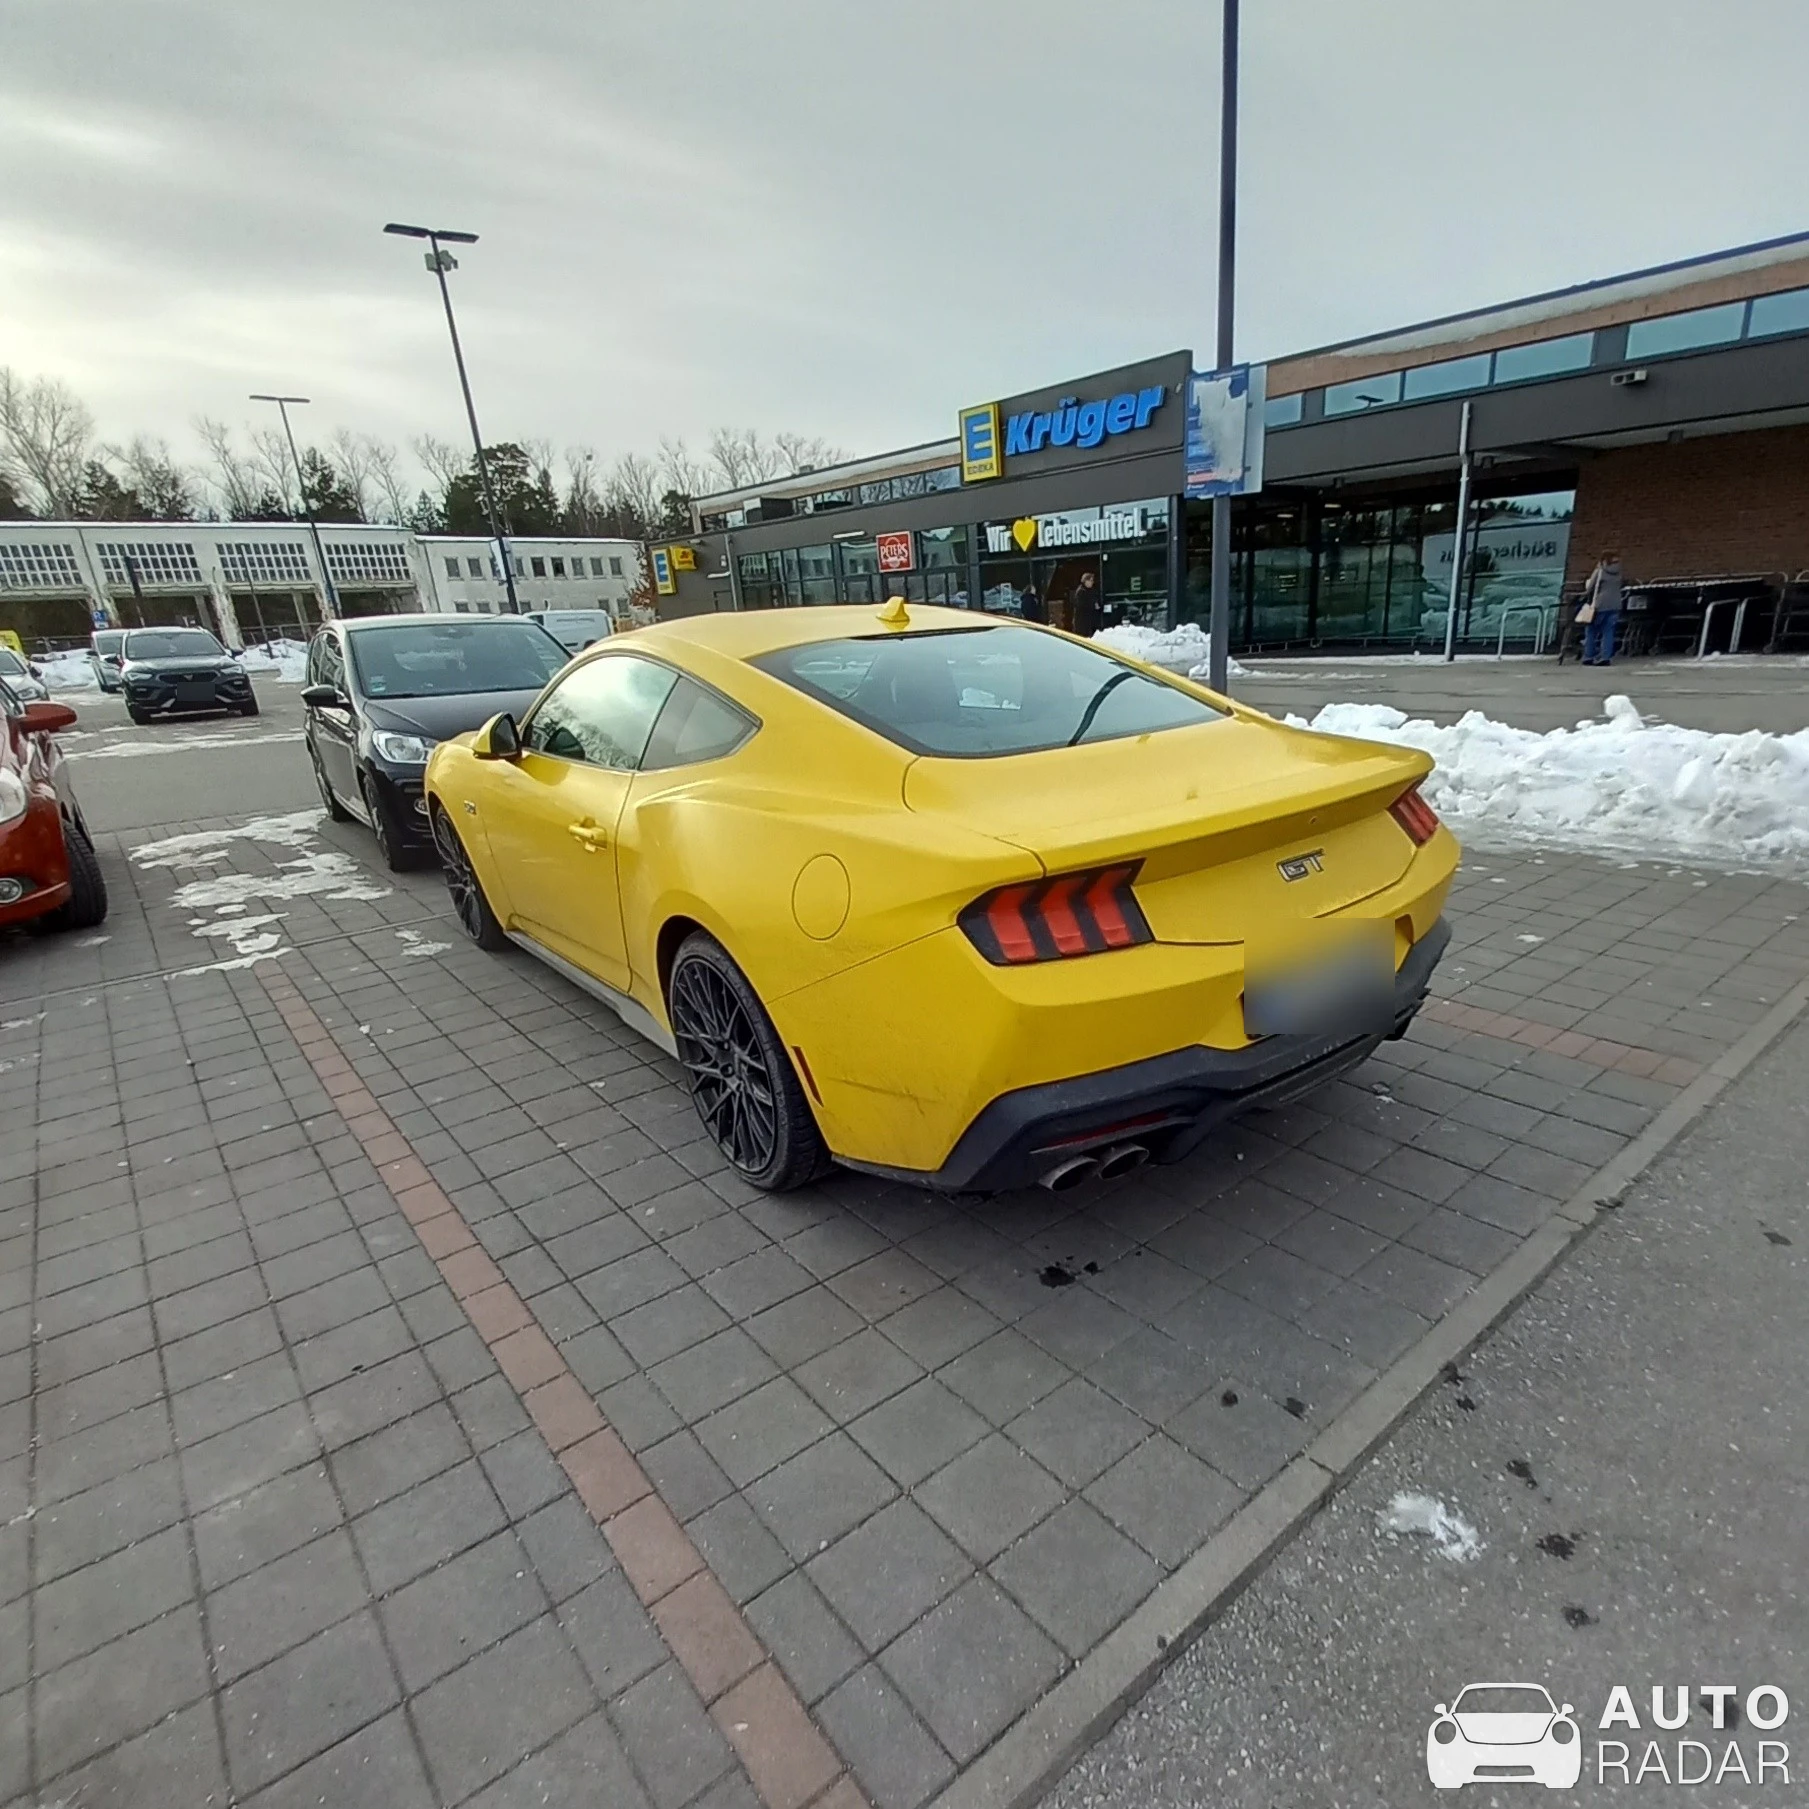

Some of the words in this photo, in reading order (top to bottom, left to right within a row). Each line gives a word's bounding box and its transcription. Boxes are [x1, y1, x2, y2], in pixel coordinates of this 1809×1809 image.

[1005, 384, 1165, 457] Krüger
[965, 411, 993, 462] E
[880, 543, 908, 562] PETERS
[986, 525, 1012, 553] Wir
[654, 553, 669, 582] E
[1130, 577, 1141, 591] E
[1276, 848, 1324, 882] GT
